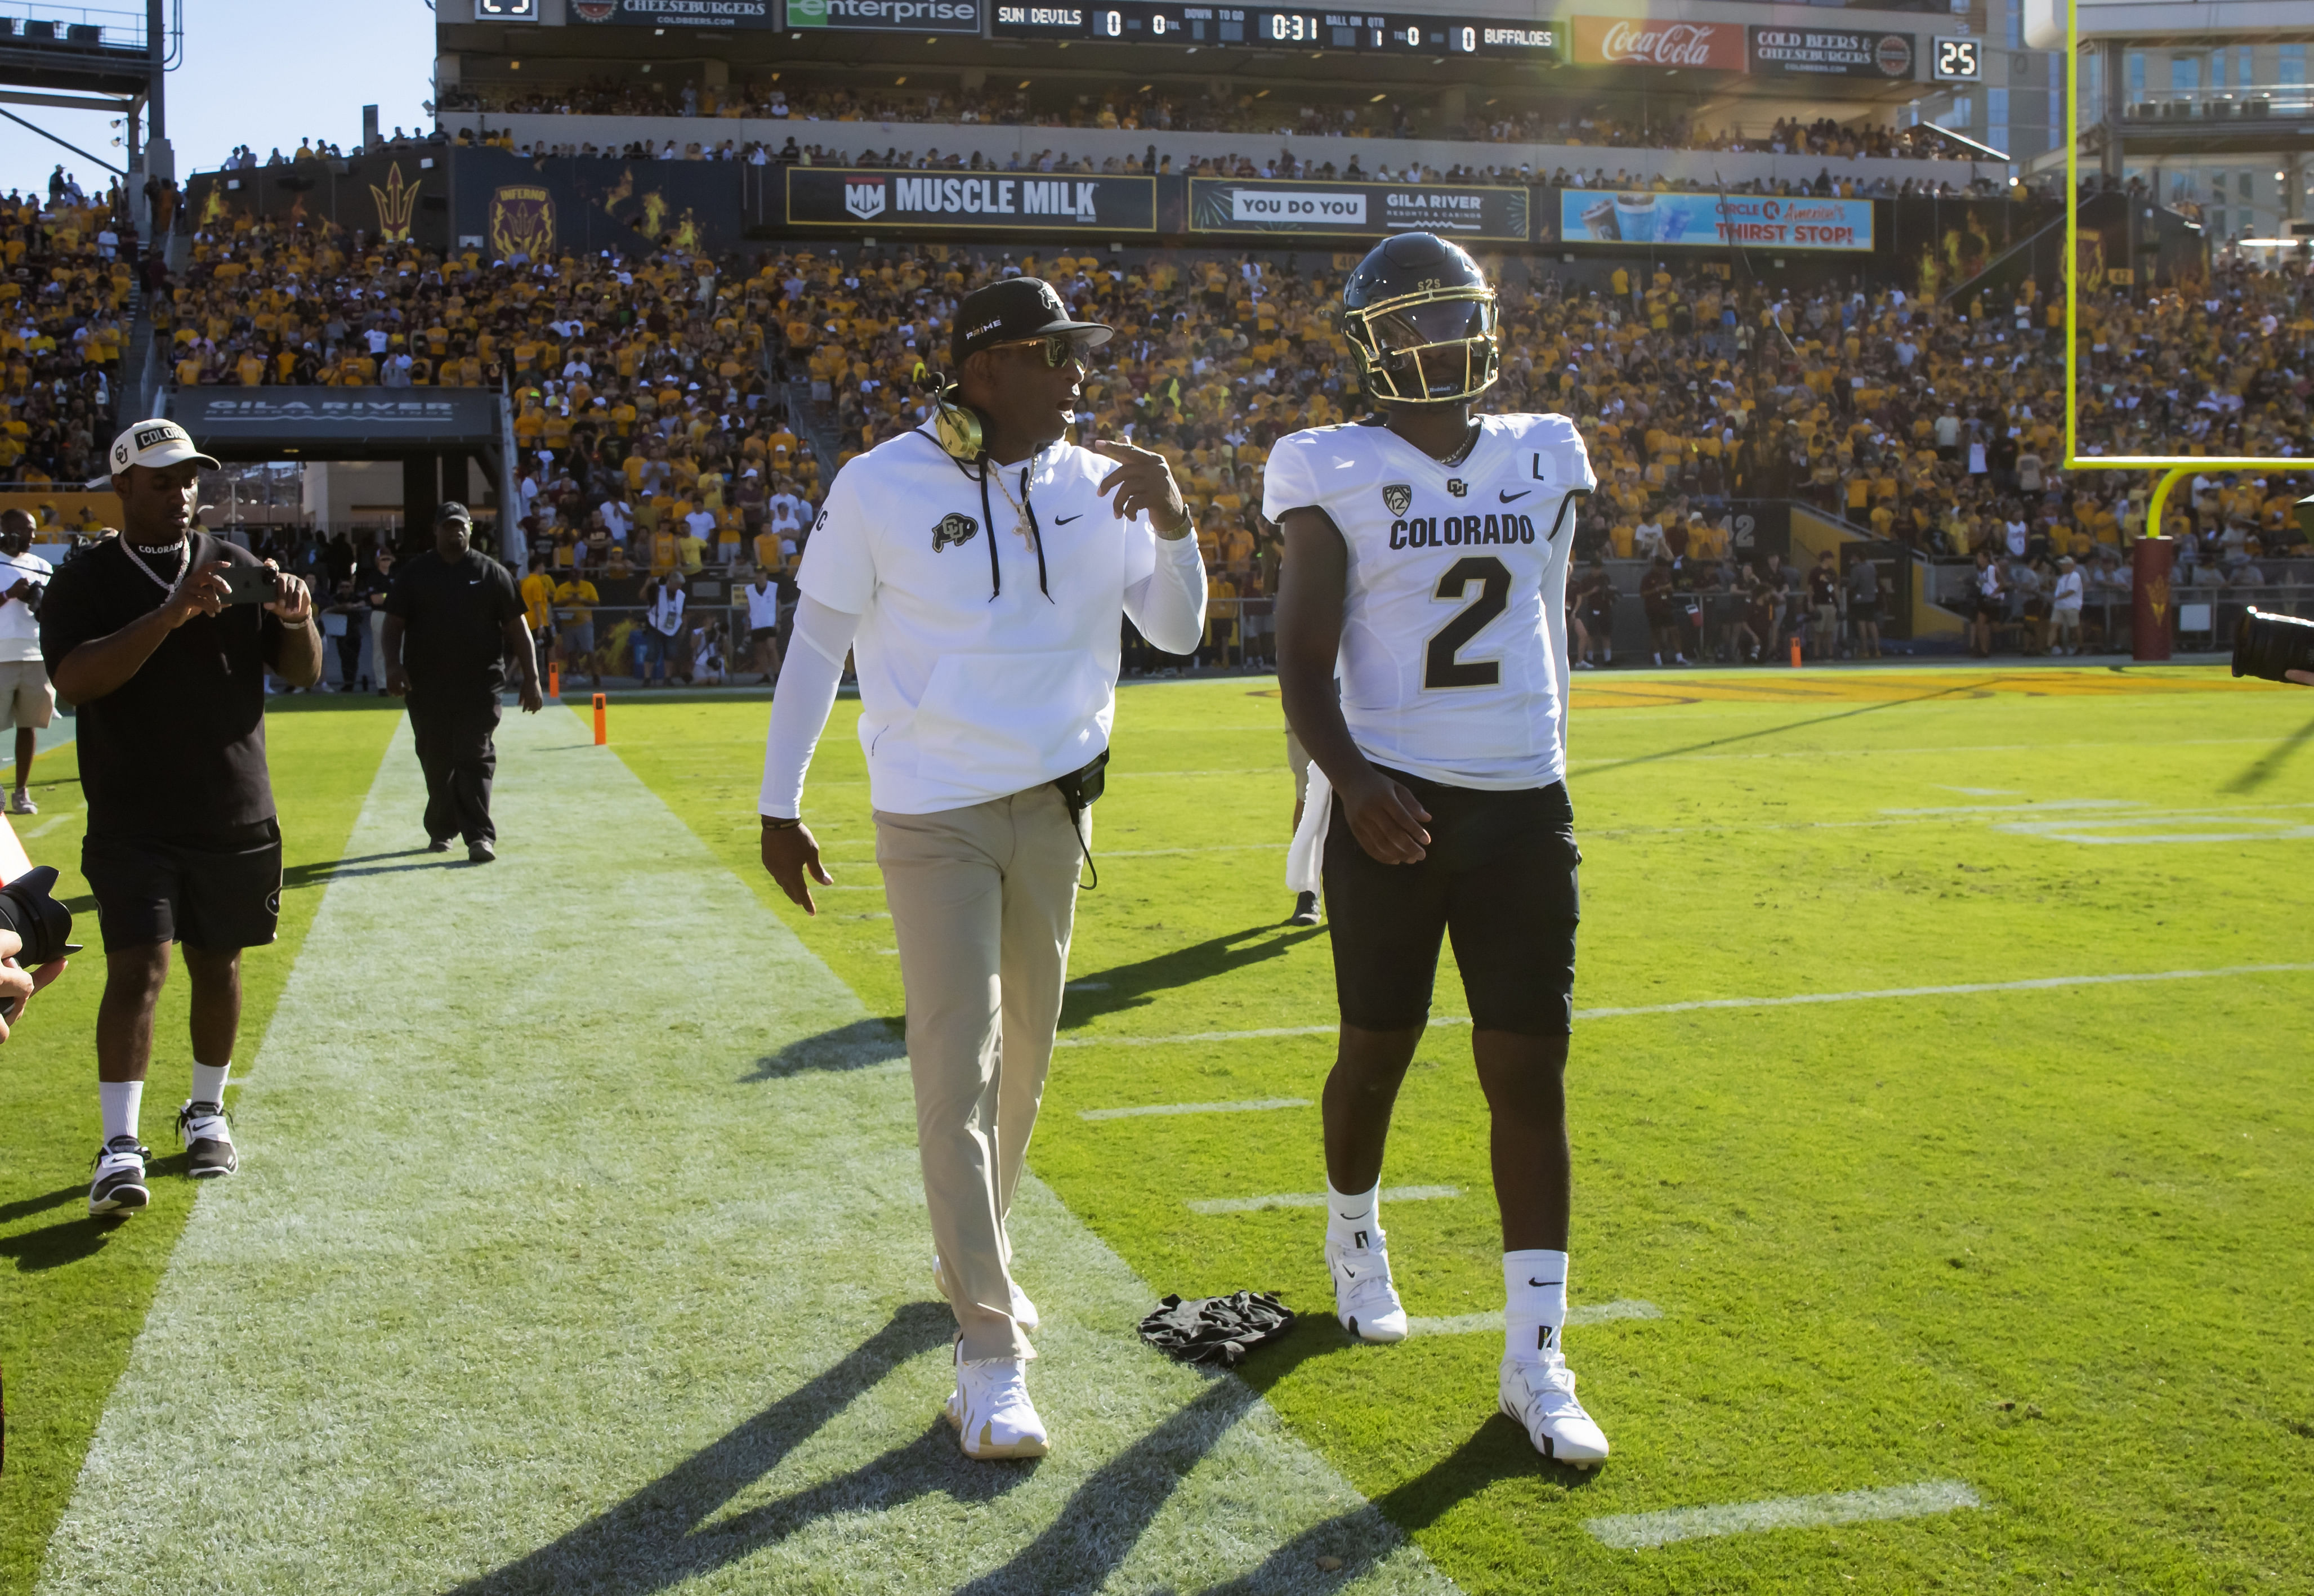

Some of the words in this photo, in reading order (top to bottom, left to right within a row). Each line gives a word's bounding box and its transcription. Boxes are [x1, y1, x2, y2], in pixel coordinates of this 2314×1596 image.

[624, 0, 766, 15] CHEESEBURGERS
[801, 0, 975, 23] enterprise
[998, 7, 1025, 23] SUN
[1031, 8, 1082, 25] DEVILS
[1185, 8, 1212, 19] DOWN
[1218, 10, 1231, 21] TO
[1232, 10, 1245, 21] GO
[656, 16, 735, 26] COLDBEERS.COM
[1107, 11, 1121, 36] 0
[1153, 15, 1165, 34] 0
[1272, 14, 1317, 41] 0:31
[1325, 15, 1347, 26] BALL
[1367, 17, 1385, 28] QTR
[1377, 30, 1382, 47] 1
[1408, 26, 1419, 46] 0
[1462, 26, 1476, 52] 0
[1484, 28, 1552, 46] BUFFALOES
[1602, 21, 1716, 65] Coca-Cola
[1757, 31, 1802, 47] COLD
[1805, 34, 1859, 50] BEERS
[1758, 47, 1872, 64] CHEESEBURGERS
[1940, 42, 1976, 75] 25
[500, 189, 546, 202] INFERNO
[896, 178, 1015, 213] MUSCLE
[1023, 181, 1097, 216] MILK
[1386, 193, 1427, 208] GILA
[1430, 195, 1481, 210] RIVER
[1243, 199, 1281, 214] YOU
[1288, 200, 1315, 214] DO
[1320, 201, 1358, 216] YOU
[1716, 203, 1760, 216] CIRCLE
[1715, 222, 1788, 241] THIRST
[1794, 225, 1853, 244] STOP!
[1339, 256, 1357, 269] 40
[966, 319, 1002, 341] PRIME
[208, 401, 312, 410] GILA
[321, 401, 453, 410] RIVER
[1533, 453, 1544, 481] L
[1447, 479, 1468, 497] CU
[1392, 498, 1406, 510] 12
[942, 518, 964, 539] CU
[1389, 513, 1535, 550] COLORADO
[139, 540, 183, 554] COLORADO
[1421, 555, 1514, 692] 2
